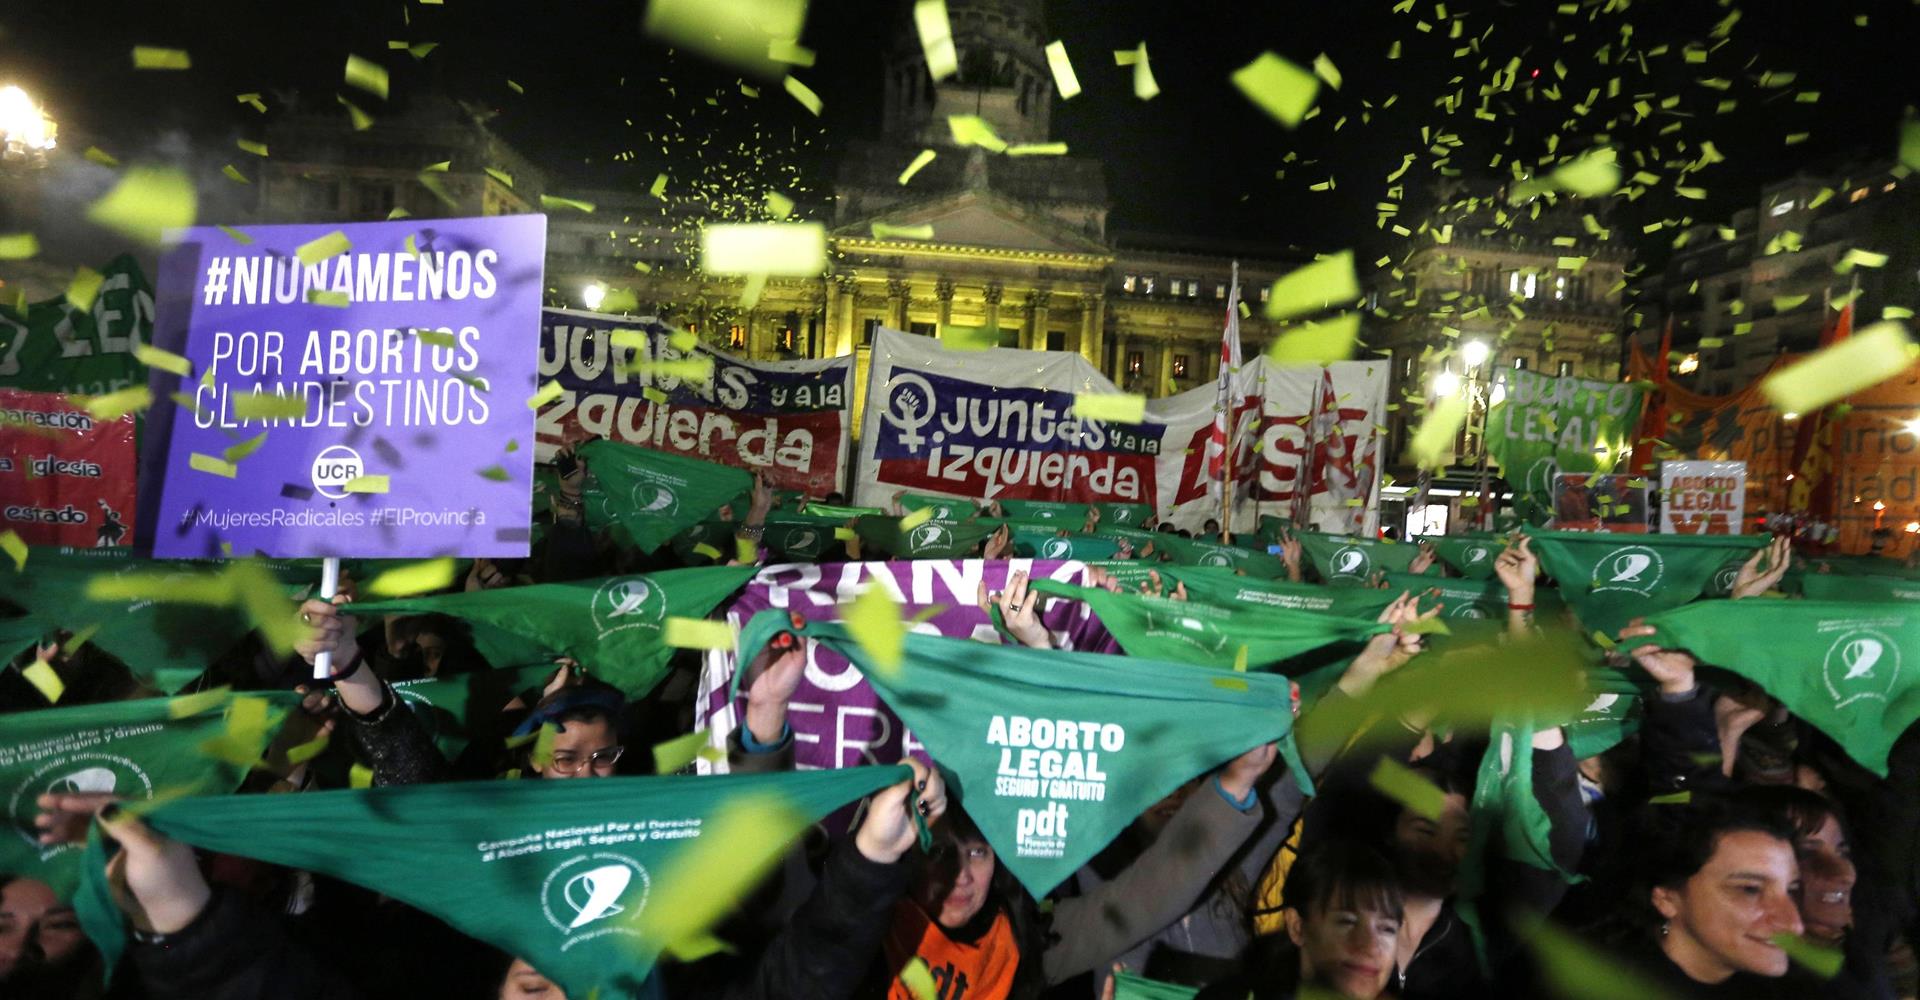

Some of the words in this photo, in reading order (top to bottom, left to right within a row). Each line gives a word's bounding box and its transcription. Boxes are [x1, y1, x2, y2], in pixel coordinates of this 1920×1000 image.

[204, 249, 498, 305] #NIUNAMENOS
[211, 331, 284, 376] POR
[299, 326, 480, 375] ABORTOS
[317, 464, 358, 480] UCR
[1671, 476, 1737, 491] ABORTO
[1669, 492, 1737, 511] LEGAL
[5, 505, 88, 524] estado
[181, 508, 364, 530] #MujeresRadicales
[986, 715, 1125, 752] ABORTO
[997, 748, 1107, 781] LEGAL
[995, 776, 1040, 798] SEGURO
[1041, 778, 1050, 798] Y
[1049, 779, 1106, 801] GRATUITO
[545, 823, 605, 840] Nacional
[606, 821, 630, 834] Por
[633, 820, 646, 831] el
[649, 817, 702, 830] Derecho
[1016, 801, 1069, 845] pdt
[589, 832, 636, 846] Seguro
[650, 828, 702, 841] Gratuito
